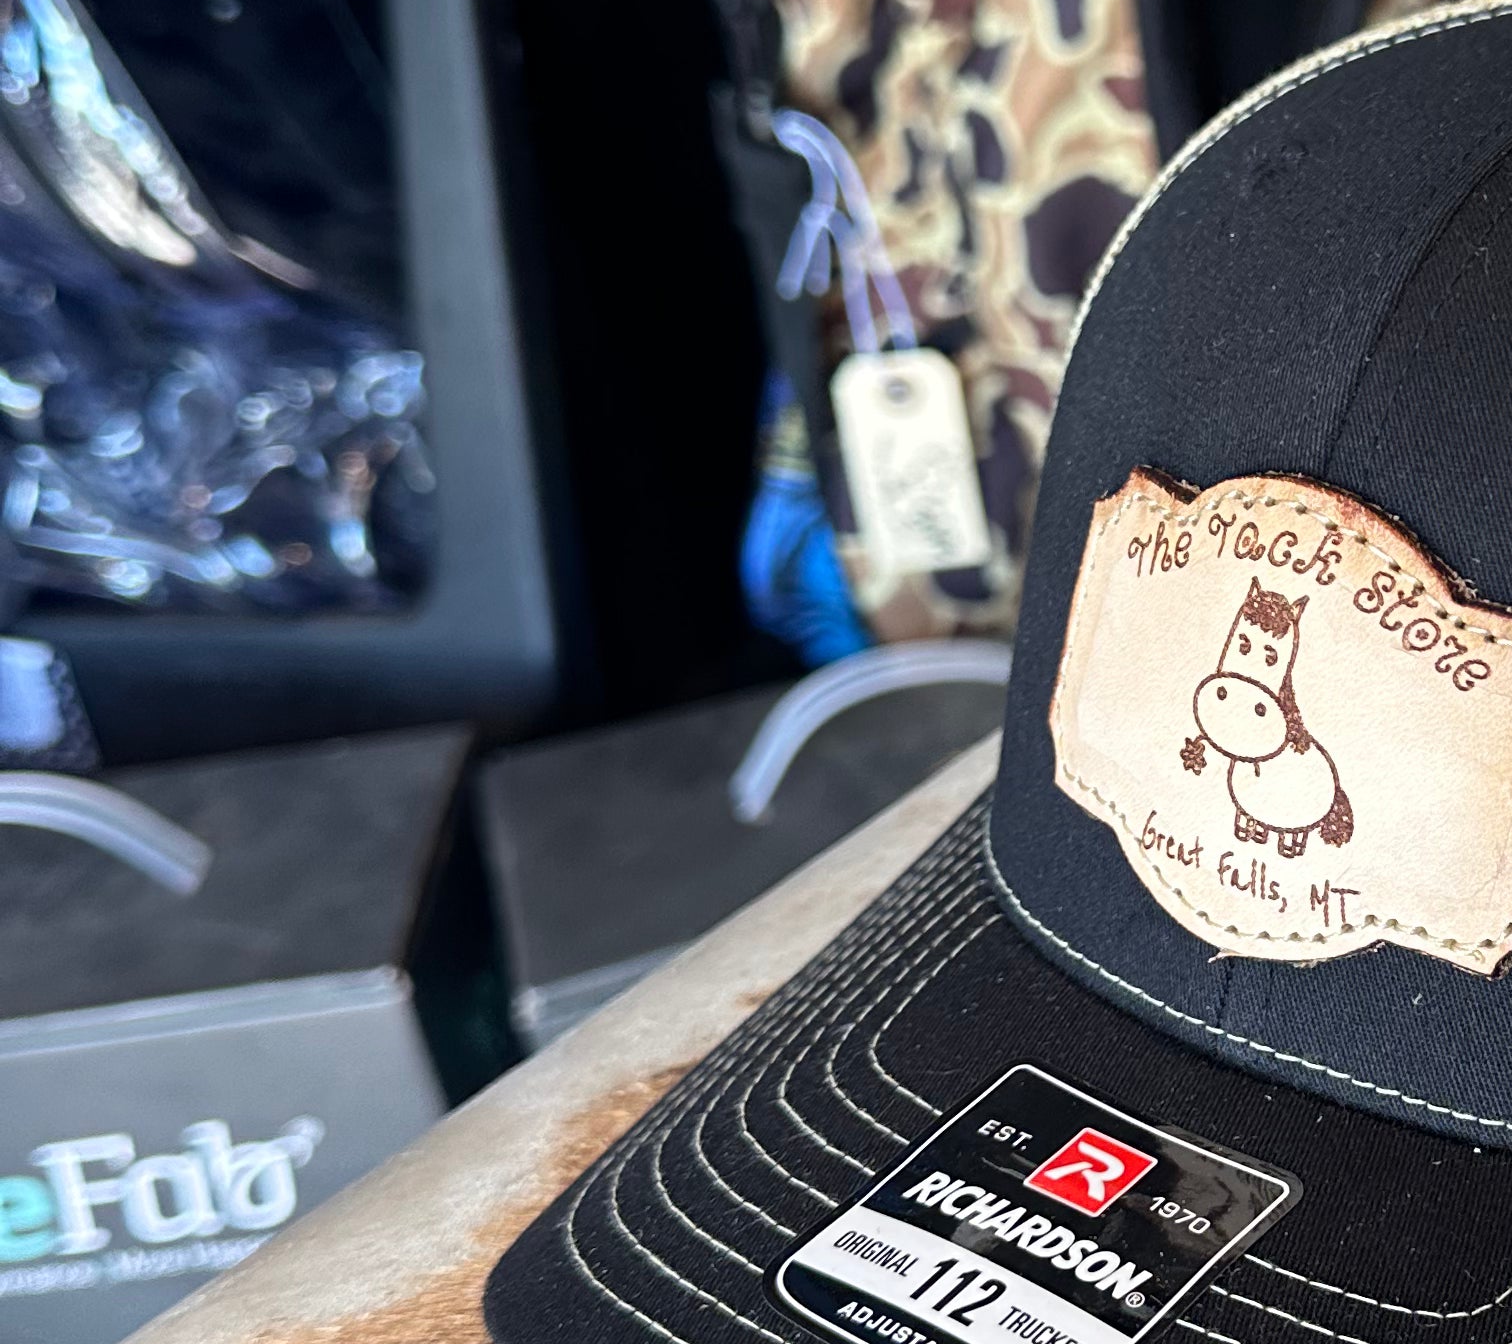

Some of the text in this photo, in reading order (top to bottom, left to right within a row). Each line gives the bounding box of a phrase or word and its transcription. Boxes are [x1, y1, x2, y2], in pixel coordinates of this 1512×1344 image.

[1128, 521, 1192, 577] The
[1208, 513, 1344, 586] Tack
[1141, 810, 1204, 868] Great
[1310, 879, 1361, 927] MT
[977, 1119, 1211, 1235] EST. 1970
[833, 1230, 921, 1278] ORIGINAL
[910, 1257, 1010, 1328] 112
